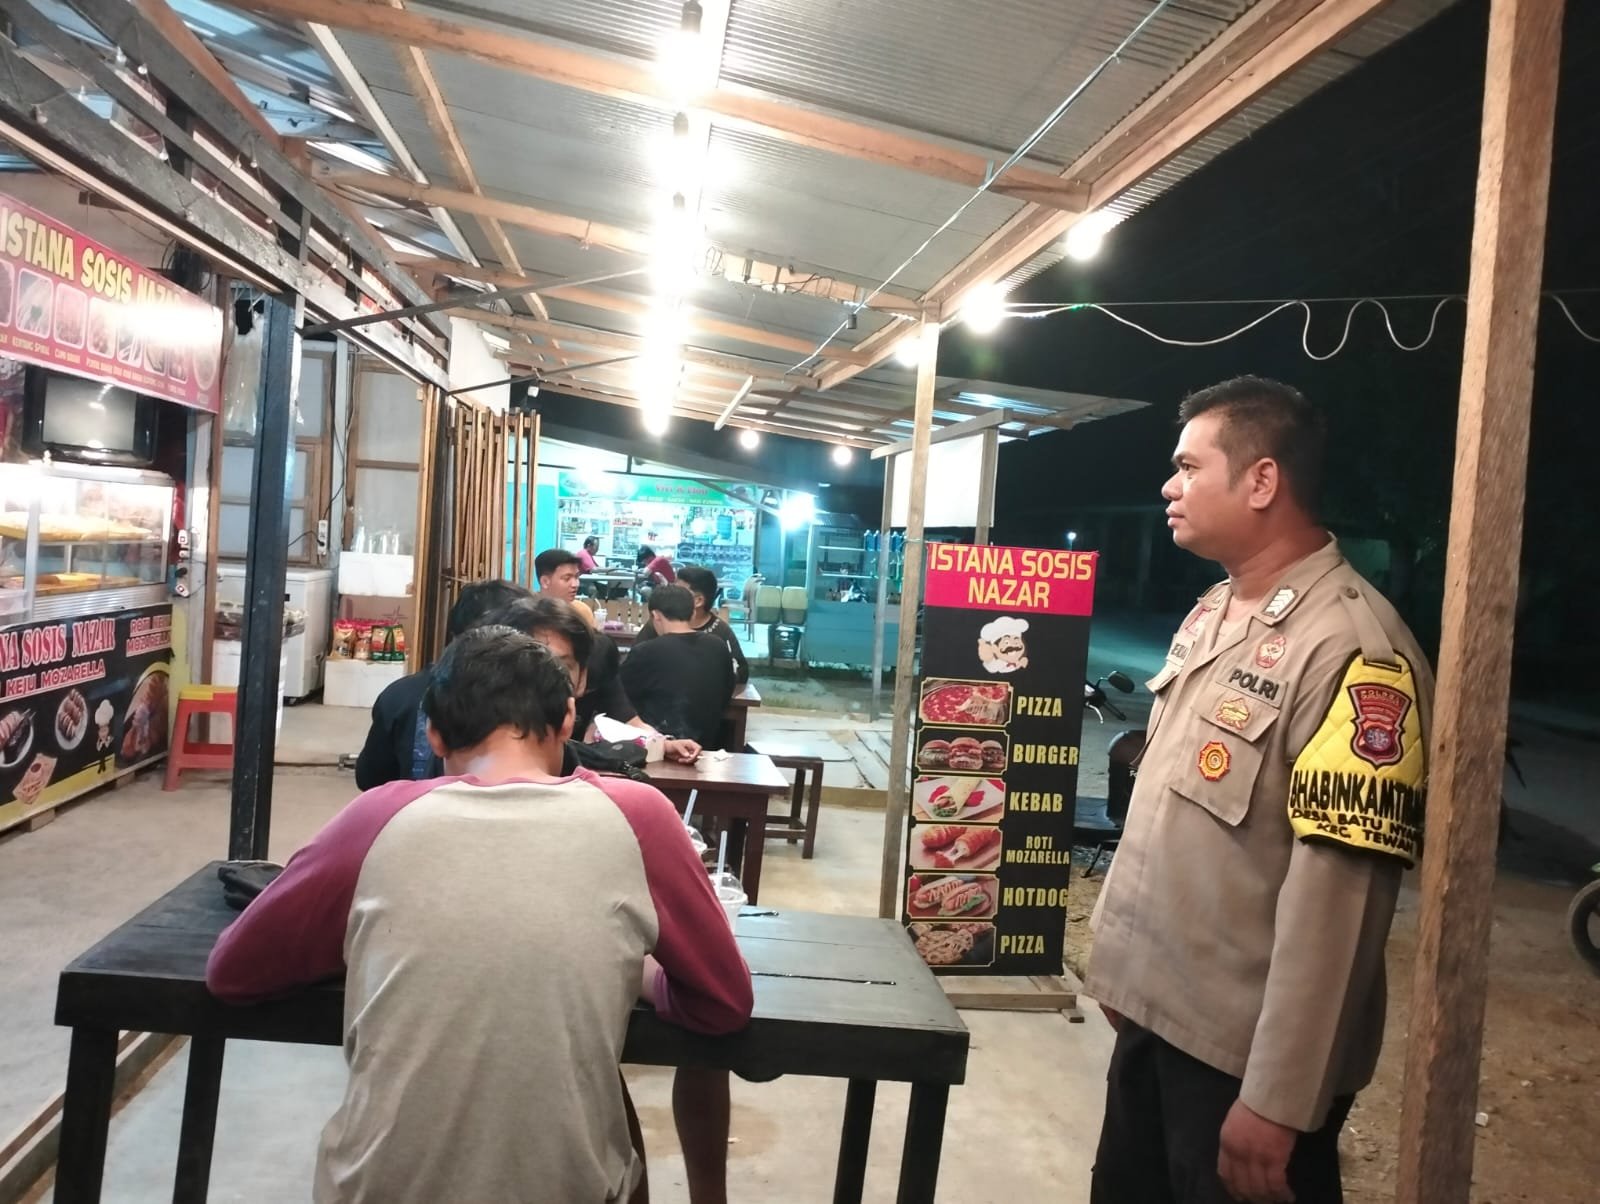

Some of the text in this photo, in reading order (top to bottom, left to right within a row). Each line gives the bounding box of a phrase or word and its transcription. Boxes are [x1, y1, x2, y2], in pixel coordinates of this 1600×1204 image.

[0, 207, 75, 281] ISTANA
[81, 247, 132, 304] SOSIS
[930, 543, 1092, 580] ISTANA SOSIS
[968, 577, 1051, 608] NAZAR
[21, 623, 67, 668] SOSIS
[72, 617, 116, 658] NAZAR
[6, 659, 106, 696] KEJU MOZARELLA
[1228, 668, 1280, 701] POLRI
[1017, 696, 1063, 717] PIZZA
[1013, 743, 1079, 766] BURGER
[1009, 791, 1064, 813] KEBAB
[1291, 809, 1332, 824] DESA
[1337, 813, 1383, 830] BATU
[1026, 835, 1053, 850] ROTI
[1006, 849, 1070, 865] MOZARELLA
[1003, 887, 1068, 907] HOTDOG
[1000, 935, 1045, 954] PIZZA
